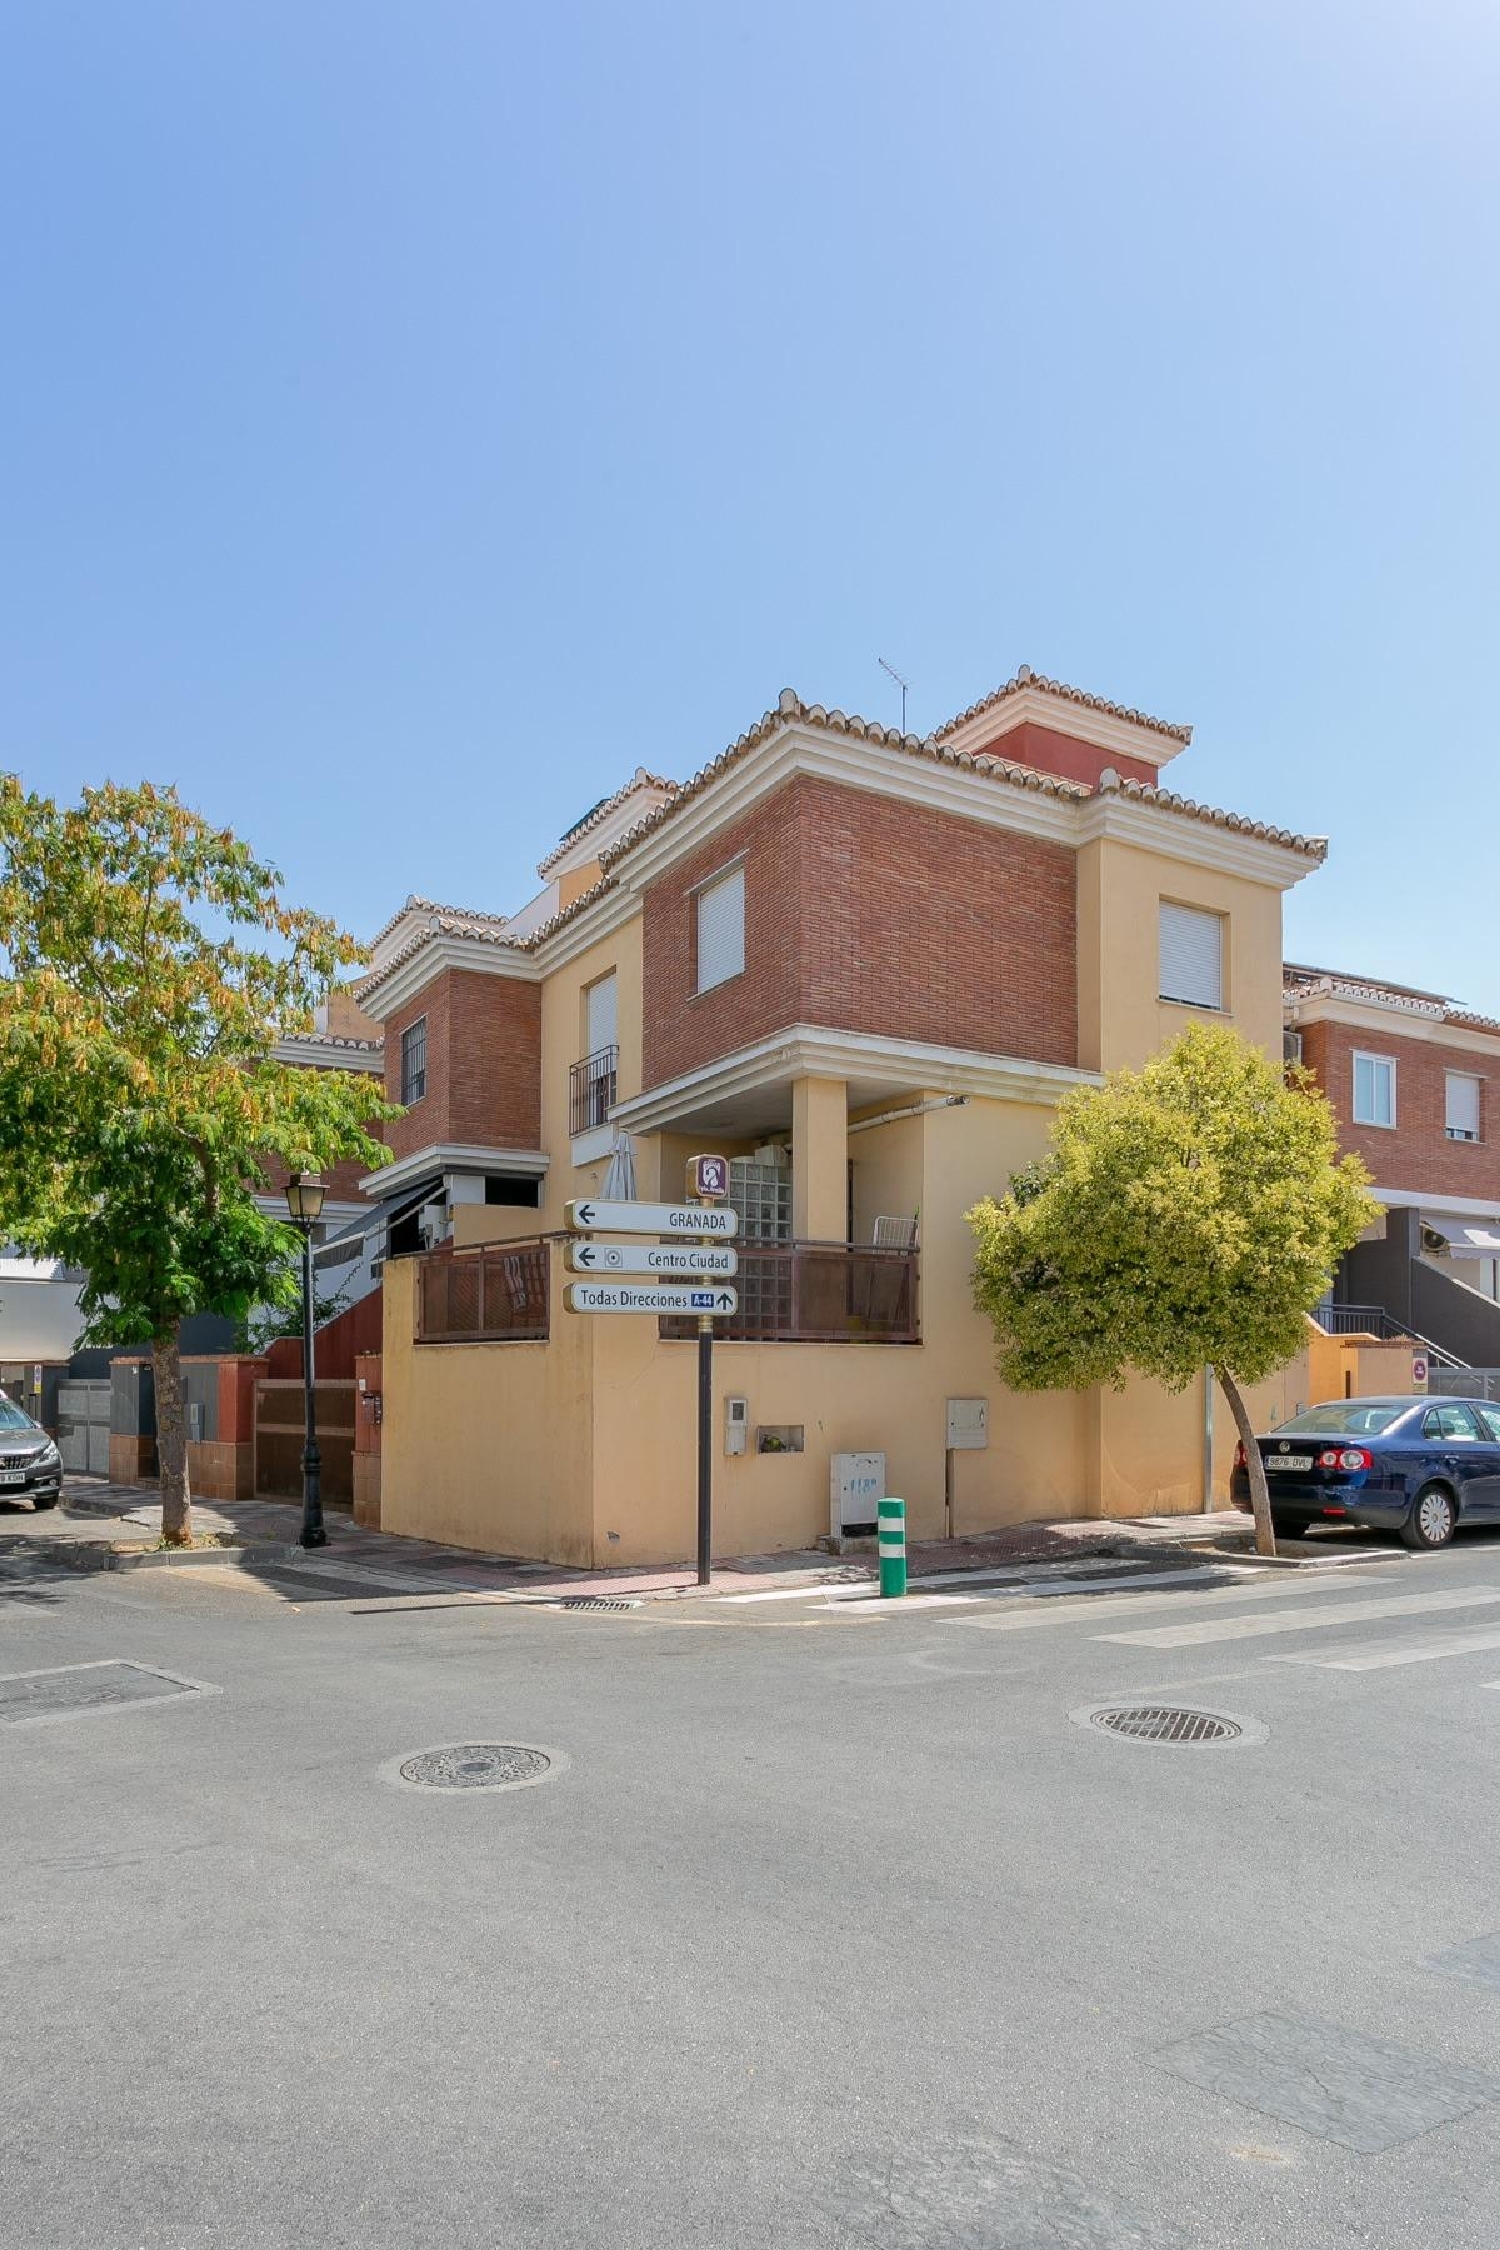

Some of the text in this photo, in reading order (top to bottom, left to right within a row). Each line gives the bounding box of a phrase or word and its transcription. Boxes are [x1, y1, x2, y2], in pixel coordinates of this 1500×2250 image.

[669, 1212, 726, 1229] GRANADA
[648, 1252, 729, 1269] Centro Ciudad
[580, 1289, 713, 1307] Todas Direcciones A-44
